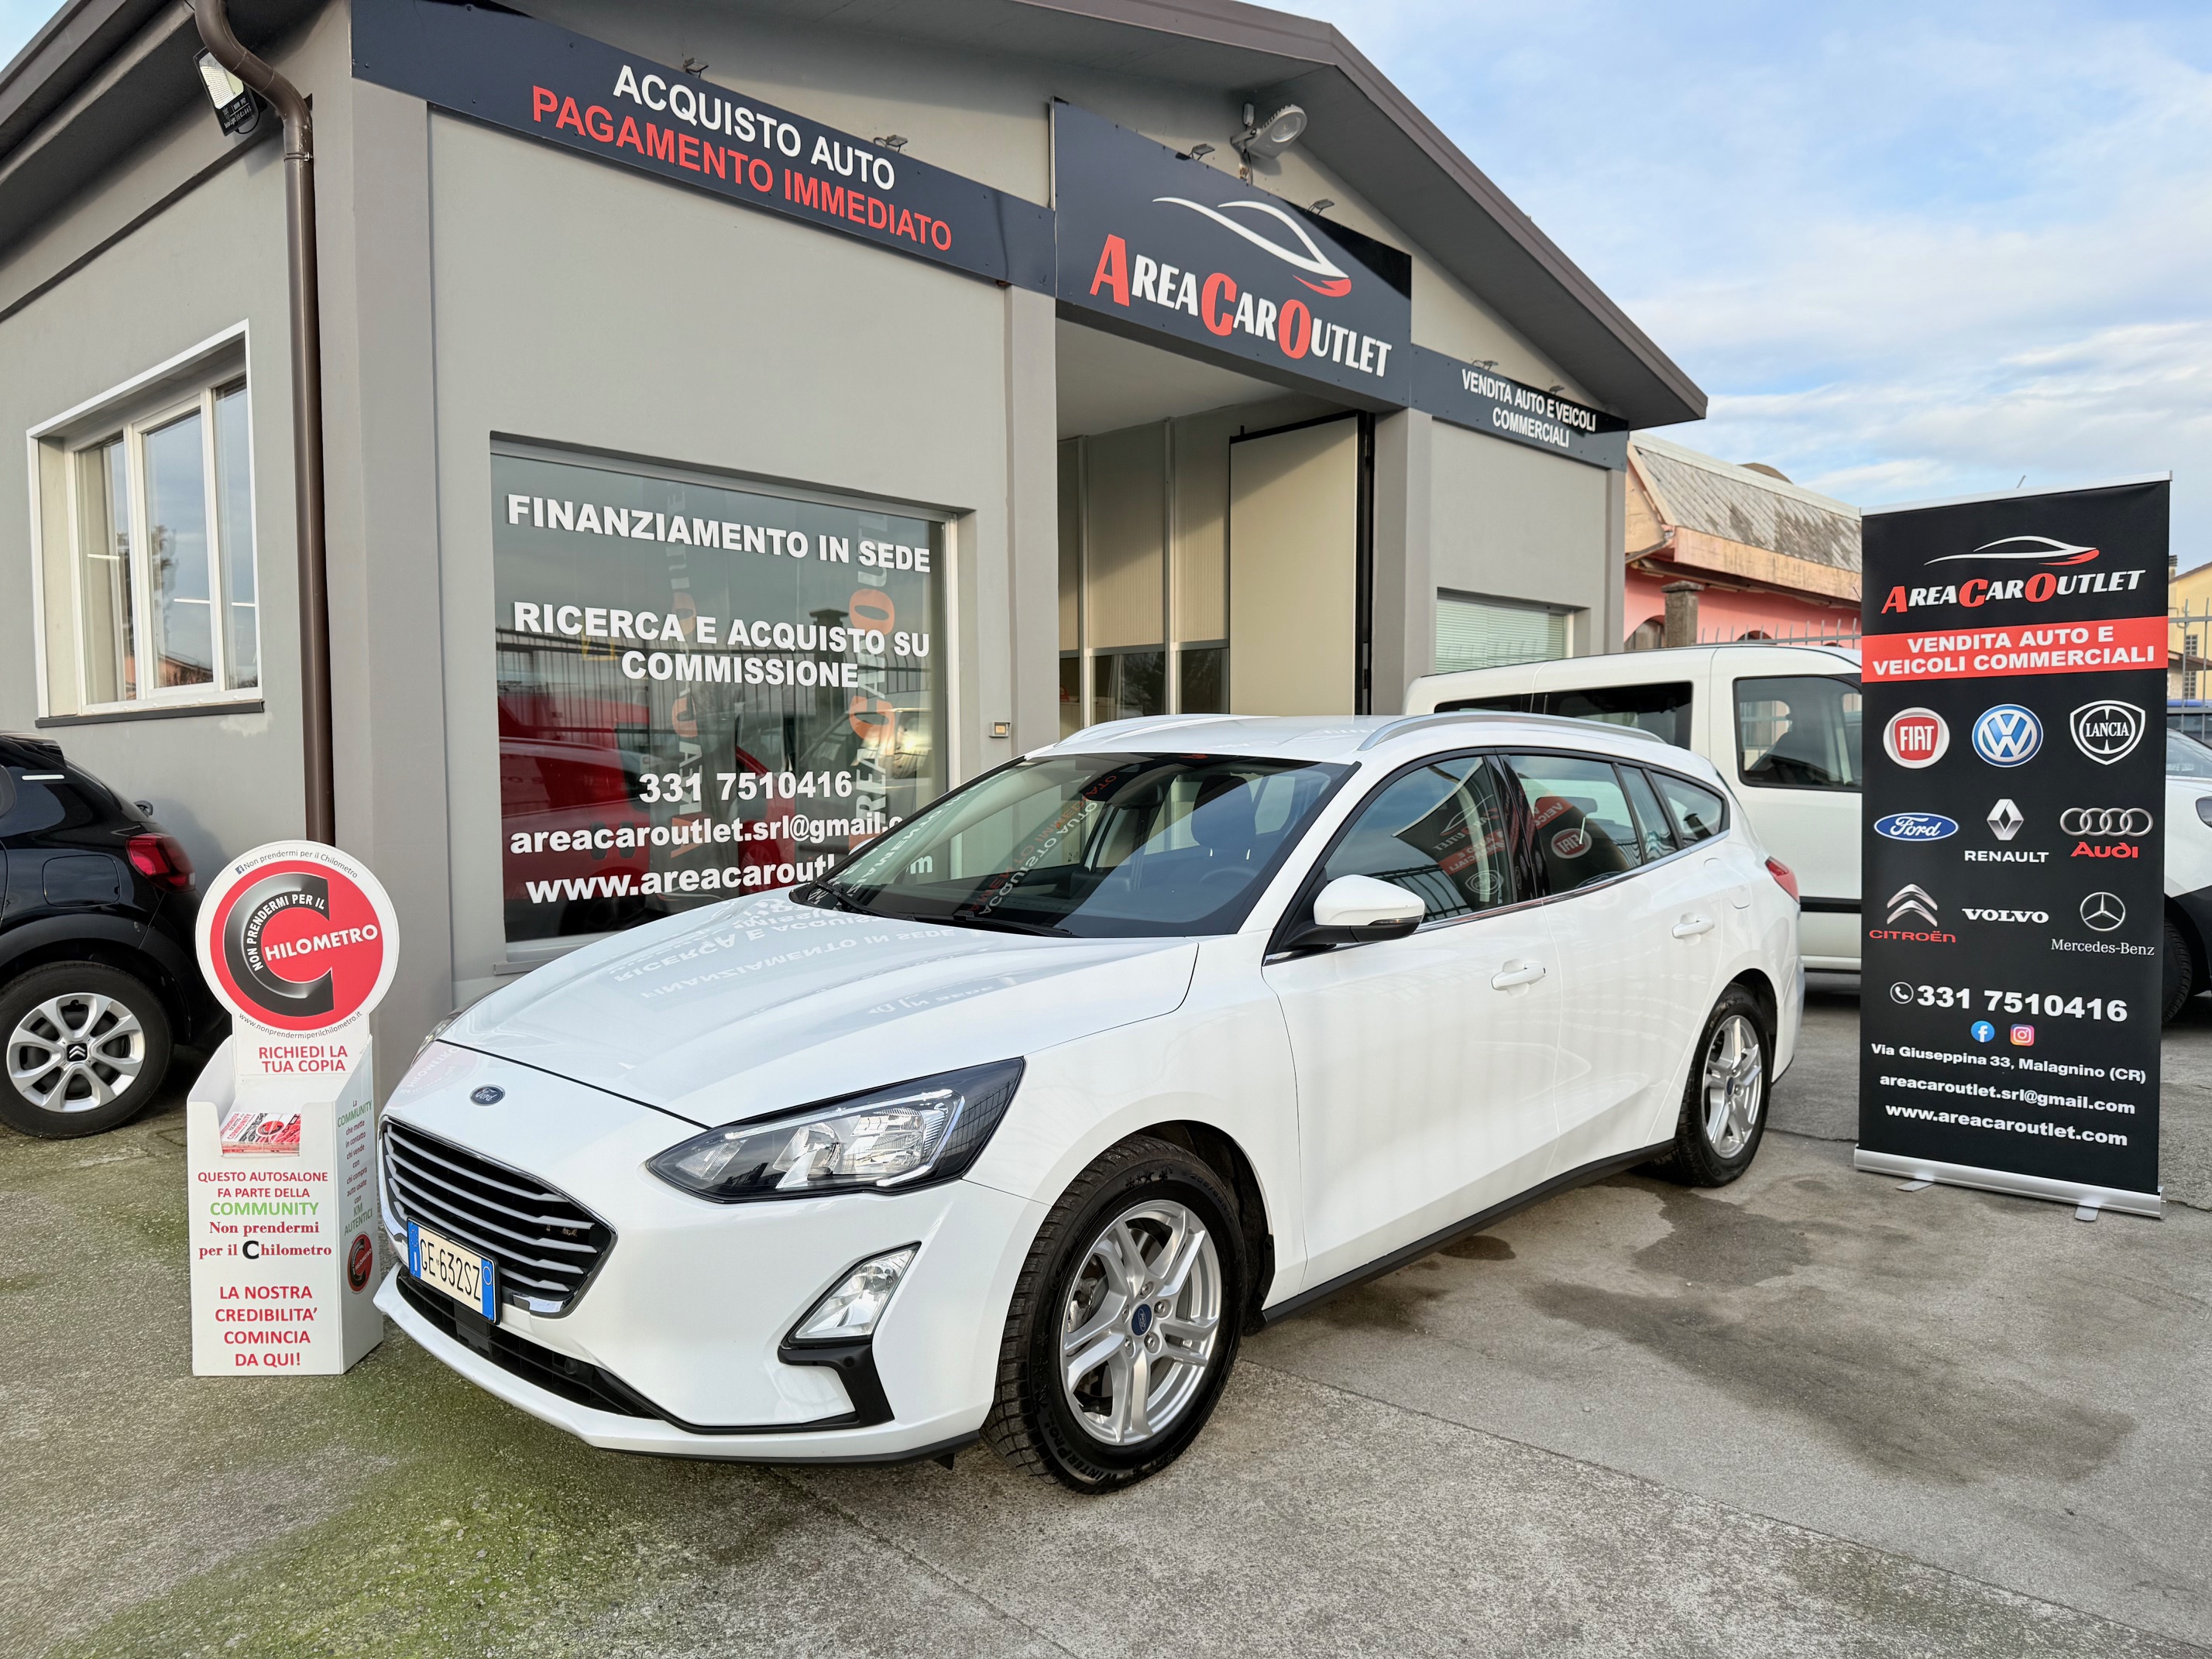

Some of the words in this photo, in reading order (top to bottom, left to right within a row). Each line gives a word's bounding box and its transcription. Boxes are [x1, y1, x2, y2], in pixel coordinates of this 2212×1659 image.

[613, 64, 802, 157] ACQUISTO
[811, 136, 895, 191] AUTO
[532, 85, 774, 192] PAGAMENTO
[785, 168, 952, 251] IMMEDIATO
[1461, 368, 1512, 404] VENDITA
[1513, 387, 1546, 417] AUTO
[1546, 397, 1554, 417] E
[1554, 402, 1596, 433] VEICOLI
[1492, 407, 1569, 448] COMMERCIALI
[507, 493, 809, 558] FINANZIAMENTO
[818, 534, 850, 564] IN
[857, 540, 931, 573] SEDE
[513, 601, 685, 643] RICERCA
[696, 615, 716, 644] E
[726, 618, 886, 654] ACQUISTO
[893, 631, 930, 658] SU
[1907, 633, 2012, 654] VENDITA
[2018, 628, 2089, 647] AUTO
[2098, 626, 2114, 642] E
[620, 650, 859, 689] COMMISSIONE
[1872, 658, 1966, 676] VEICOLI
[1973, 646, 2155, 671] COMMERCIALI
[1900, 724, 1935, 751] FIAT
[2085, 722, 2130, 738] LANCIA
[639, 772, 702, 803] 331
[716, 770, 853, 801] 7510416
[1889, 816, 1942, 837] Ford
[1964, 850, 2049, 863] RENAULT
[2070, 841, 2139, 858] Audi
[244, 860, 257, 870] Non
[259, 850, 299, 866] prendermi
[300, 850, 312, 859] per
[321, 854, 358, 878] Chilometro
[291, 893, 313, 905] PER
[315, 896, 325, 910] IL
[246, 894, 290, 945] PRENDERMI
[1961, 908, 2049, 924] VOLVO
[246, 946, 264, 972] NON
[2051, 938, 2155, 956] Mercedes-Benz
[1917, 984, 1970, 1009] 331
[1984, 989, 2128, 1022] 7510416
[239, 1011, 362, 1039] www.nonprendermiperilchilometro.it
[259, 1046, 325, 1060] RICHIEDI
[329, 1045, 349, 1058] LA
[1871, 1043, 1895, 1056] Via
[1899, 1046, 1987, 1068] Giuseppina
[1990, 1056, 2015, 1070] 33,
[2018, 1058, 2105, 1079] Malagnino
[2109, 1066, 2146, 1084] (CR)
[261, 1060, 294, 1073] TUA
[298, 1059, 346, 1072] COPIA
[1880, 1073, 2136, 1115] areacaroutlet.srl@gmail.com
[337, 1100, 373, 1128] COMMUNITY
[1885, 1104, 2128, 1146] www.areacaroutlet.com
[198, 1171, 246, 1184] QUESTO
[249, 1171, 328, 1183] AUTOSALONE
[217, 1187, 232, 1198] FA
[235, 1187, 272, 1198] PARTE
[274, 1187, 310, 1198] DELLA
[209, 1201, 319, 1217] COMMUNITY
[344, 1208, 373, 1236] AUTENTICI
[354, 1202, 363, 1218] KM
[209, 1221, 239, 1234] Non
[242, 1221, 320, 1237] prendermi
[198, 1245, 224, 1260] per
[227, 1243, 238, 1256] il
[219, 1286, 239, 1300] LA
[245, 1285, 313, 1300] NOSTRA
[223, 1331, 311, 1345] COMINCIA
[235, 1353, 259, 1367] DA
[263, 1353, 301, 1369] QUI!
